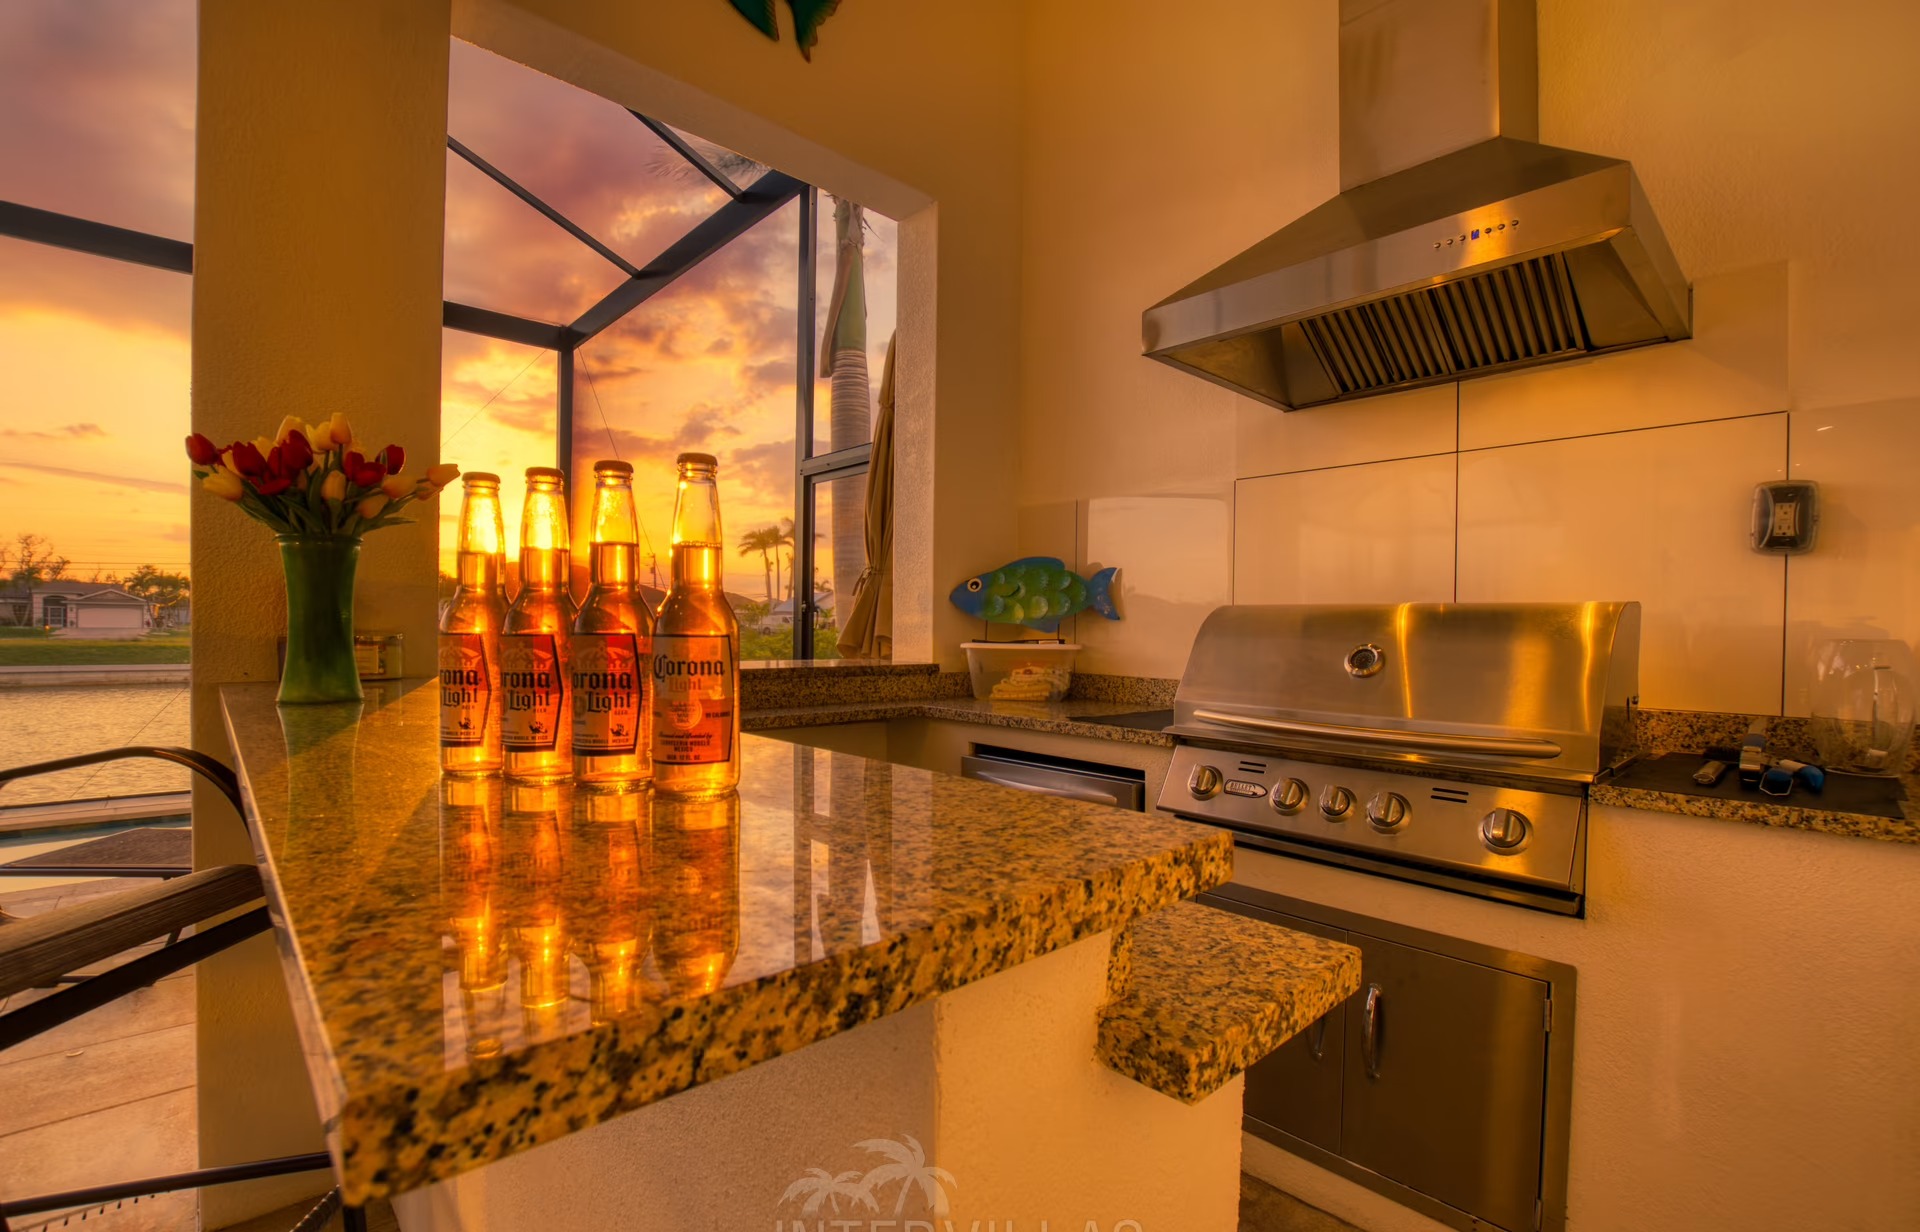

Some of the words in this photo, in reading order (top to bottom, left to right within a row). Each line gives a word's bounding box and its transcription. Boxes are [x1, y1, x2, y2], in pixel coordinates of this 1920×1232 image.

[440, 669, 479, 686] rona
[654, 654, 725, 683] Corona
[503, 672, 551, 688] rona
[573, 672, 632, 689] orona
[442, 687, 478, 707] Light
[508, 689, 550, 711] Light
[585, 691, 631, 713] Light
